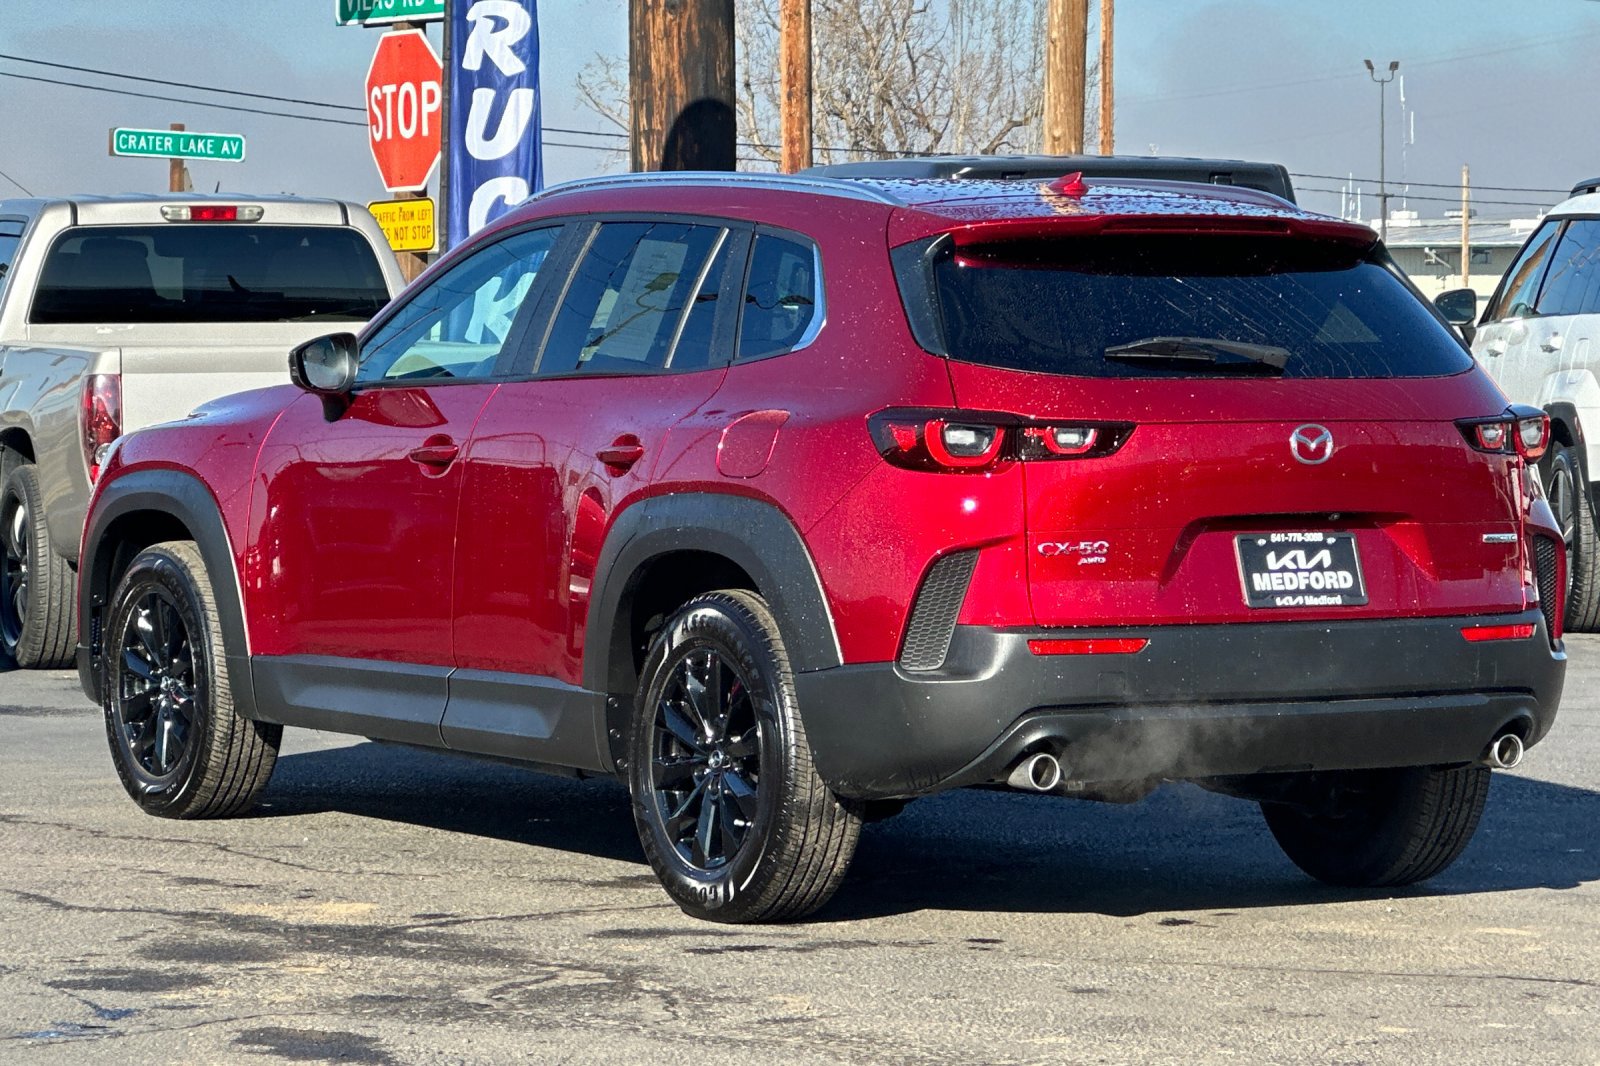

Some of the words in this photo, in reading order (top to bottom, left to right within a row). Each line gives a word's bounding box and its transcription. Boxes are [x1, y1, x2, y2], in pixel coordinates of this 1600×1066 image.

[370, 81, 441, 142] STOP
[119, 134, 173, 152] CRATER
[180, 138, 215, 154] LAKE
[220, 140, 240, 155] AV
[374, 212, 396, 224] RAFFIC
[399, 210, 415, 222] FROM
[417, 209, 431, 221] LEFT
[394, 226, 409, 241] NOT
[412, 225, 431, 240] STOP
[1037, 541, 1109, 557] CX-50
[1077, 556, 1107, 566] AWD
[1252, 571, 1354, 591] MEDFORD
